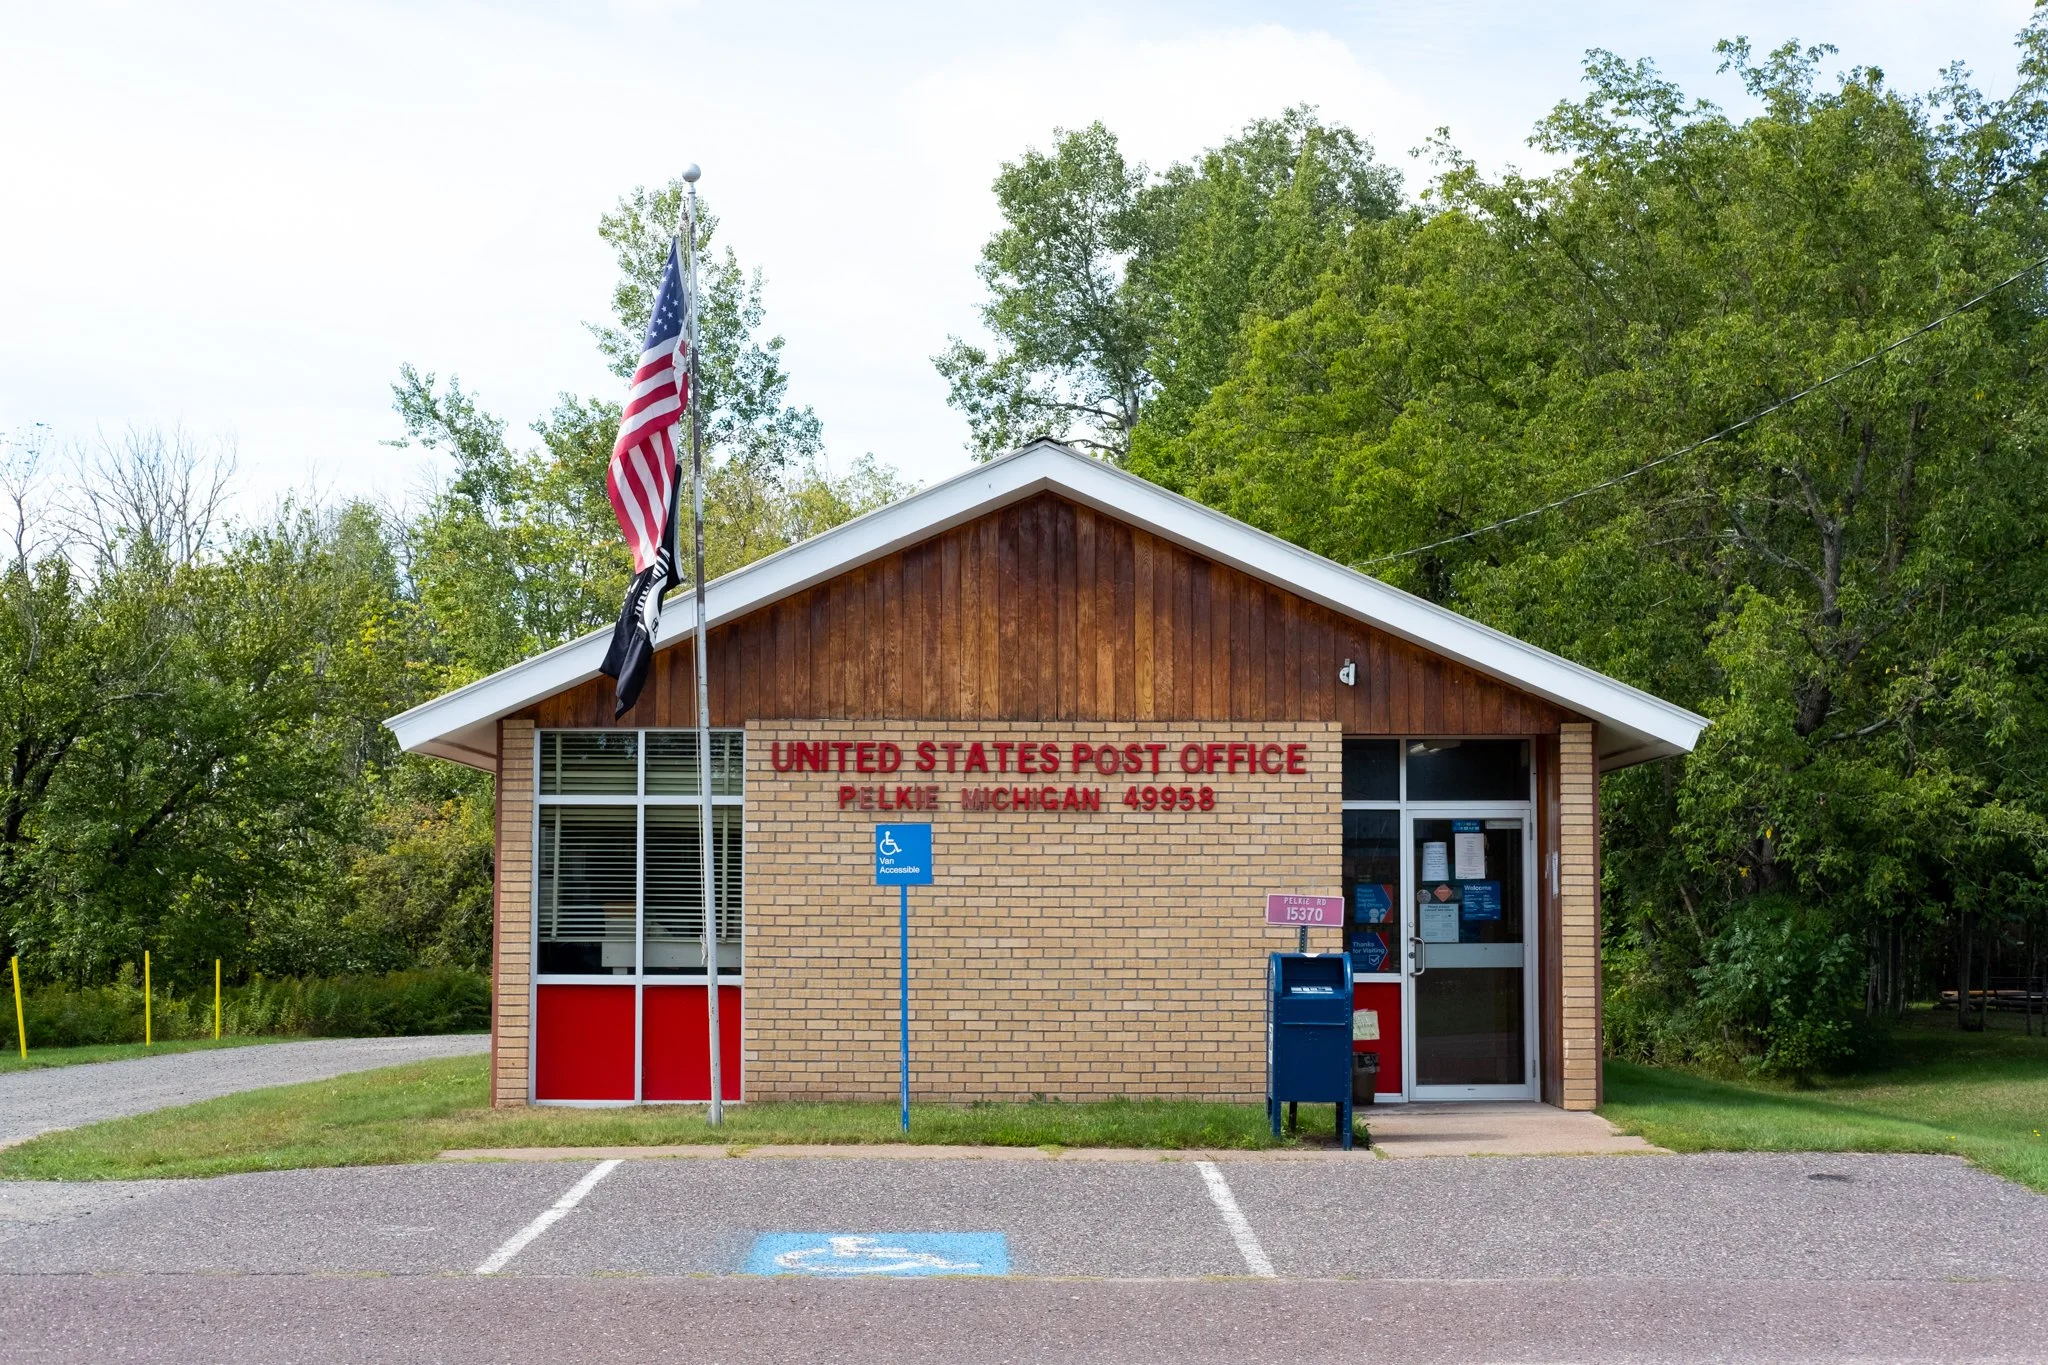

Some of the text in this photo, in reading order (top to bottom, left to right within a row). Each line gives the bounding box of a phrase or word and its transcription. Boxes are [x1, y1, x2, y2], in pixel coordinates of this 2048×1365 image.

[771, 741, 1307, 775] UNITED STATES POST OFFICE
[839, 785, 1215, 812] PELKIE MICHIGAN 49958
[1287, 907, 1323, 921] 15370
